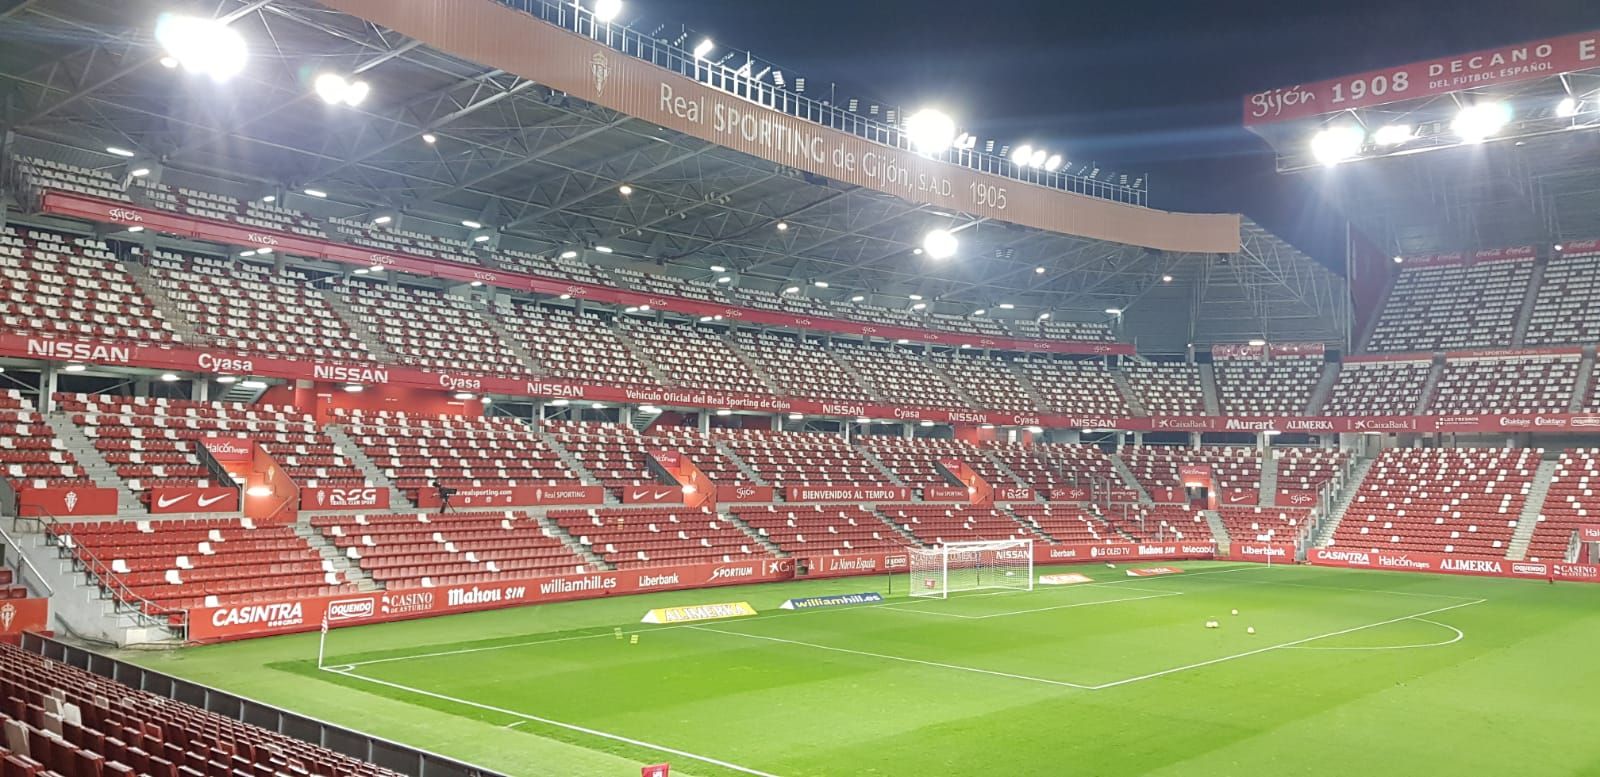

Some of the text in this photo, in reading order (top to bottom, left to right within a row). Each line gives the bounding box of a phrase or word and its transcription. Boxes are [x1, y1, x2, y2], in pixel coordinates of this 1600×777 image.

[1579, 39, 1596, 61] E
[1429, 44, 1553, 77] DECANO
[1429, 81, 1450, 89] DEL
[1500, 61, 1553, 77] ESPAÑOL
[1331, 71, 1409, 103] 1908
[659, 82, 1008, 210] Real SPORTING de Gijón, S.A.D. 1905
[28, 338, 129, 362] NISSAN
[198, 353, 253, 373] Cyasa
[313, 365, 389, 384] NISSAN
[440, 374, 481, 393] Cyasa
[527, 382, 584, 397] NISSAN
[626, 389, 661, 401] Vehículo
[663, 392, 690, 403] Oficial
[693, 395, 705, 404] del
[707, 396, 724, 405] Real
[726, 396, 759, 409] Sporting
[760, 400, 770, 408] de
[823, 404, 865, 416] NISSAN
[894, 408, 920, 420] Cyasa
[949, 413, 987, 423] NISSAN
[1014, 415, 1039, 426] Cyasa
[1070, 418, 1116, 428] NISSAN
[1170, 419, 1207, 428] CaixaBank
[1286, 420, 1334, 429] ALIMERKA
[1367, 420, 1408, 429] CaixaBank
[556, 490, 585, 498] SPORTING
[802, 490, 894, 499] BIENVENIDOS AL TEMPLO
[996, 550, 1029, 560] NISSAN
[1050, 549, 1076, 558] Liberbank
[1242, 546, 1285, 556] Liberbank
[1318, 551, 1369, 561] CASINTRA
[830, 559, 839, 570] La
[1379, 554, 1412, 567] Halcón
[1440, 559, 1502, 573] ALIMERKA
[1561, 565, 1597, 574] CASINO
[540, 576, 617, 595] williamhill.es
[639, 573, 679, 587] Liberbank
[391, 592, 433, 606] CASINO
[448, 586, 525, 606] Mahou SIN
[796, 593, 880, 608] williamhill.es
[212, 602, 303, 627] CASINTRA
[331, 602, 371, 617] OQUENDO
[400, 603, 432, 613] ASTURIAS
